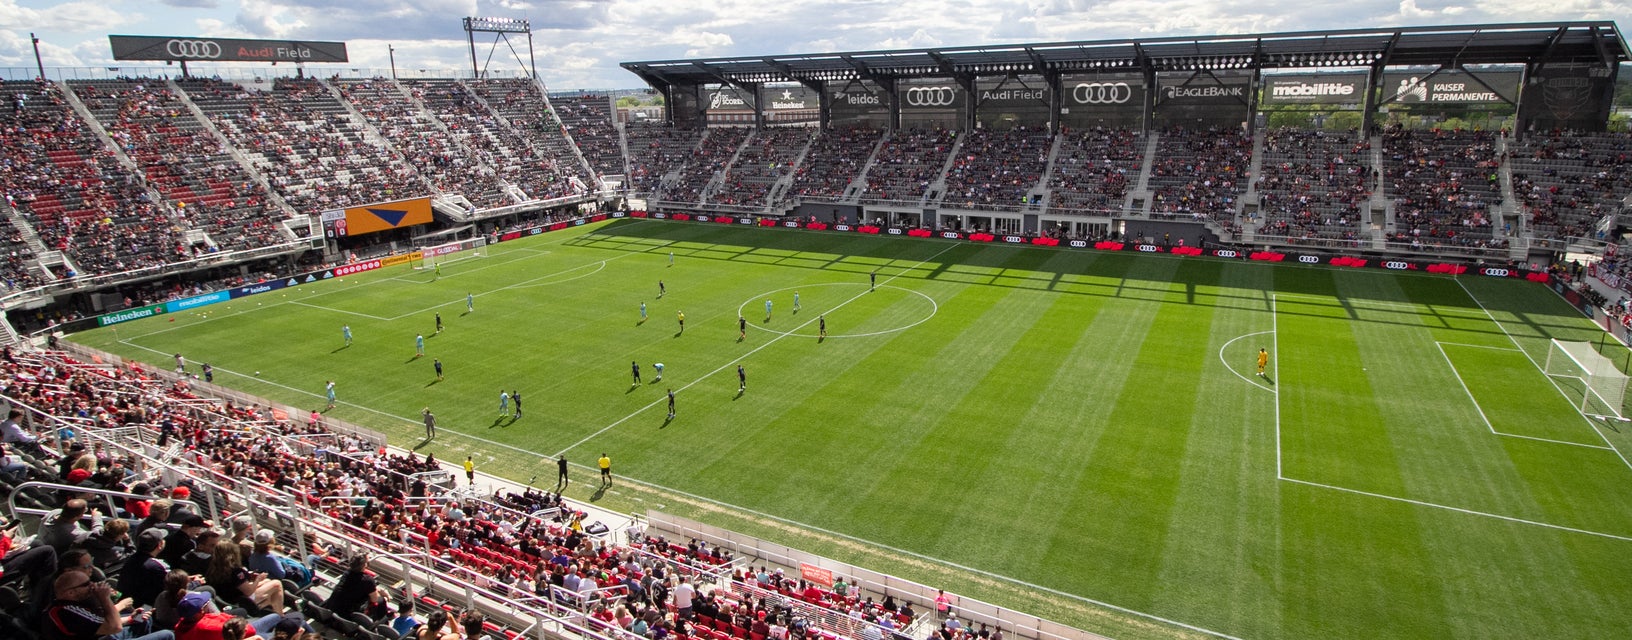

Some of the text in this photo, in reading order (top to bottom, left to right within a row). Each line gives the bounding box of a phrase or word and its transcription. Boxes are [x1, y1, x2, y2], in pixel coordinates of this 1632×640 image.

[238, 46, 311, 58] Audi Field
[1273, 83, 1354, 96] mobilitie
[1433, 83, 1464, 92] KAISER
[847, 94, 879, 104] leidos
[983, 90, 1043, 100] Audi Field
[772, 101, 804, 109] Heineken
[250, 285, 271, 293] leidos
[102, 309, 152, 325] Heineken
